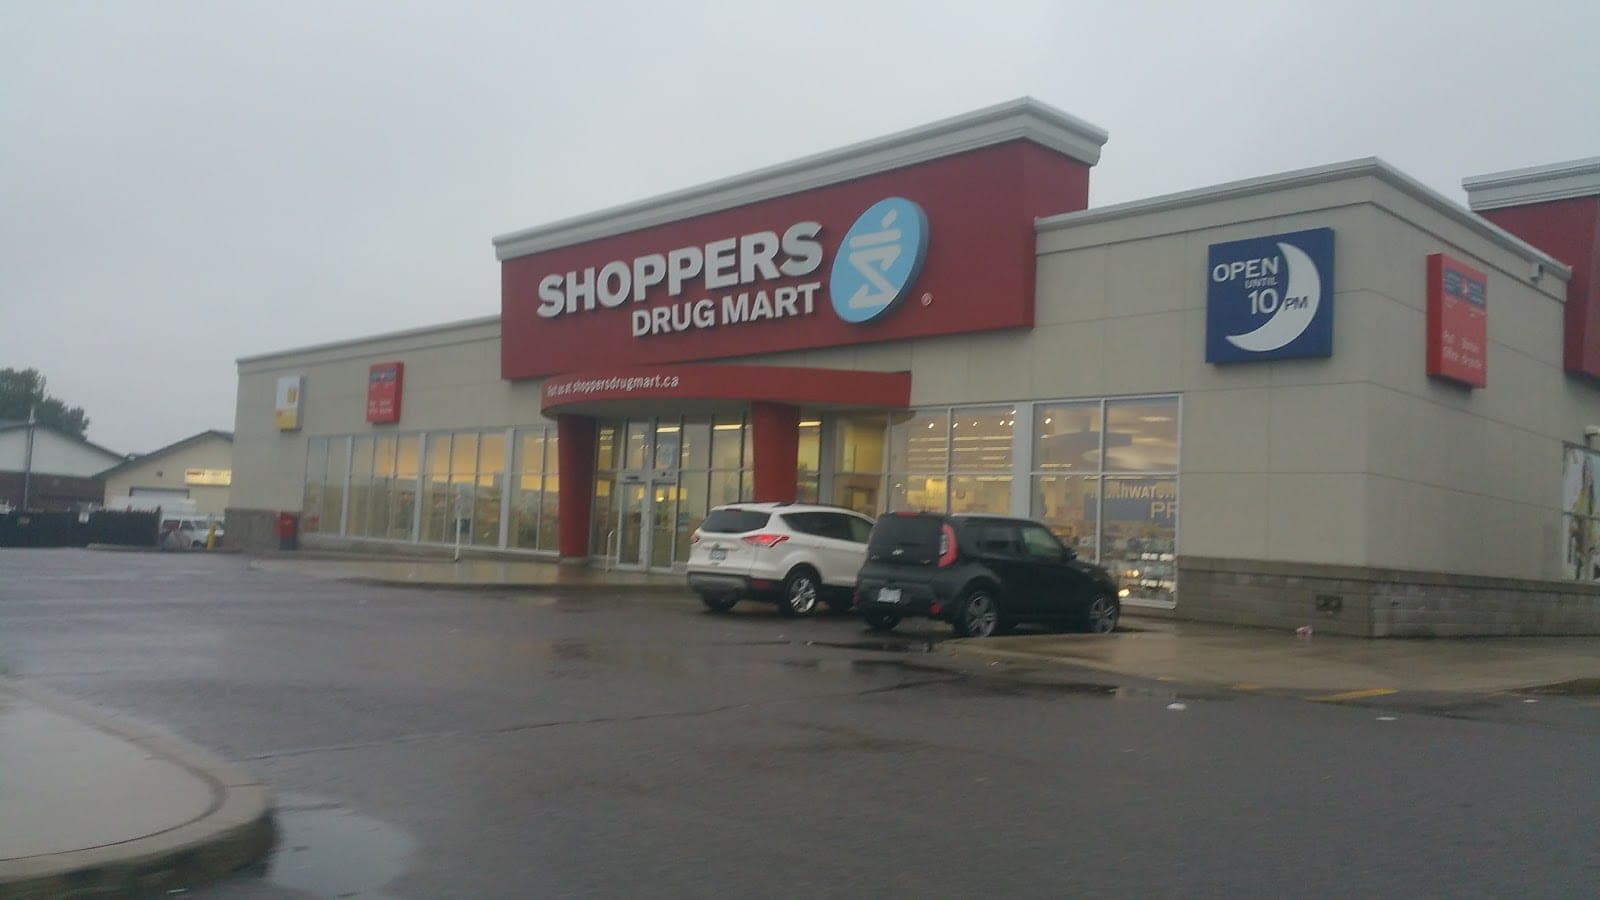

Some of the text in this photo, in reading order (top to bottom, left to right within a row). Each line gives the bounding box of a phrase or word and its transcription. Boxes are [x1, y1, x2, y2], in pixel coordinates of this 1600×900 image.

[537, 221, 823, 318] SHOPPERS
[1212, 256, 1279, 282] OPEN
[1244, 276, 1278, 289] UNTIL
[632, 281, 821, 337] DRUG MART
[1247, 288, 1309, 315] 10 PM
[573, 374, 679, 393] shoppersdrugmart.ca
